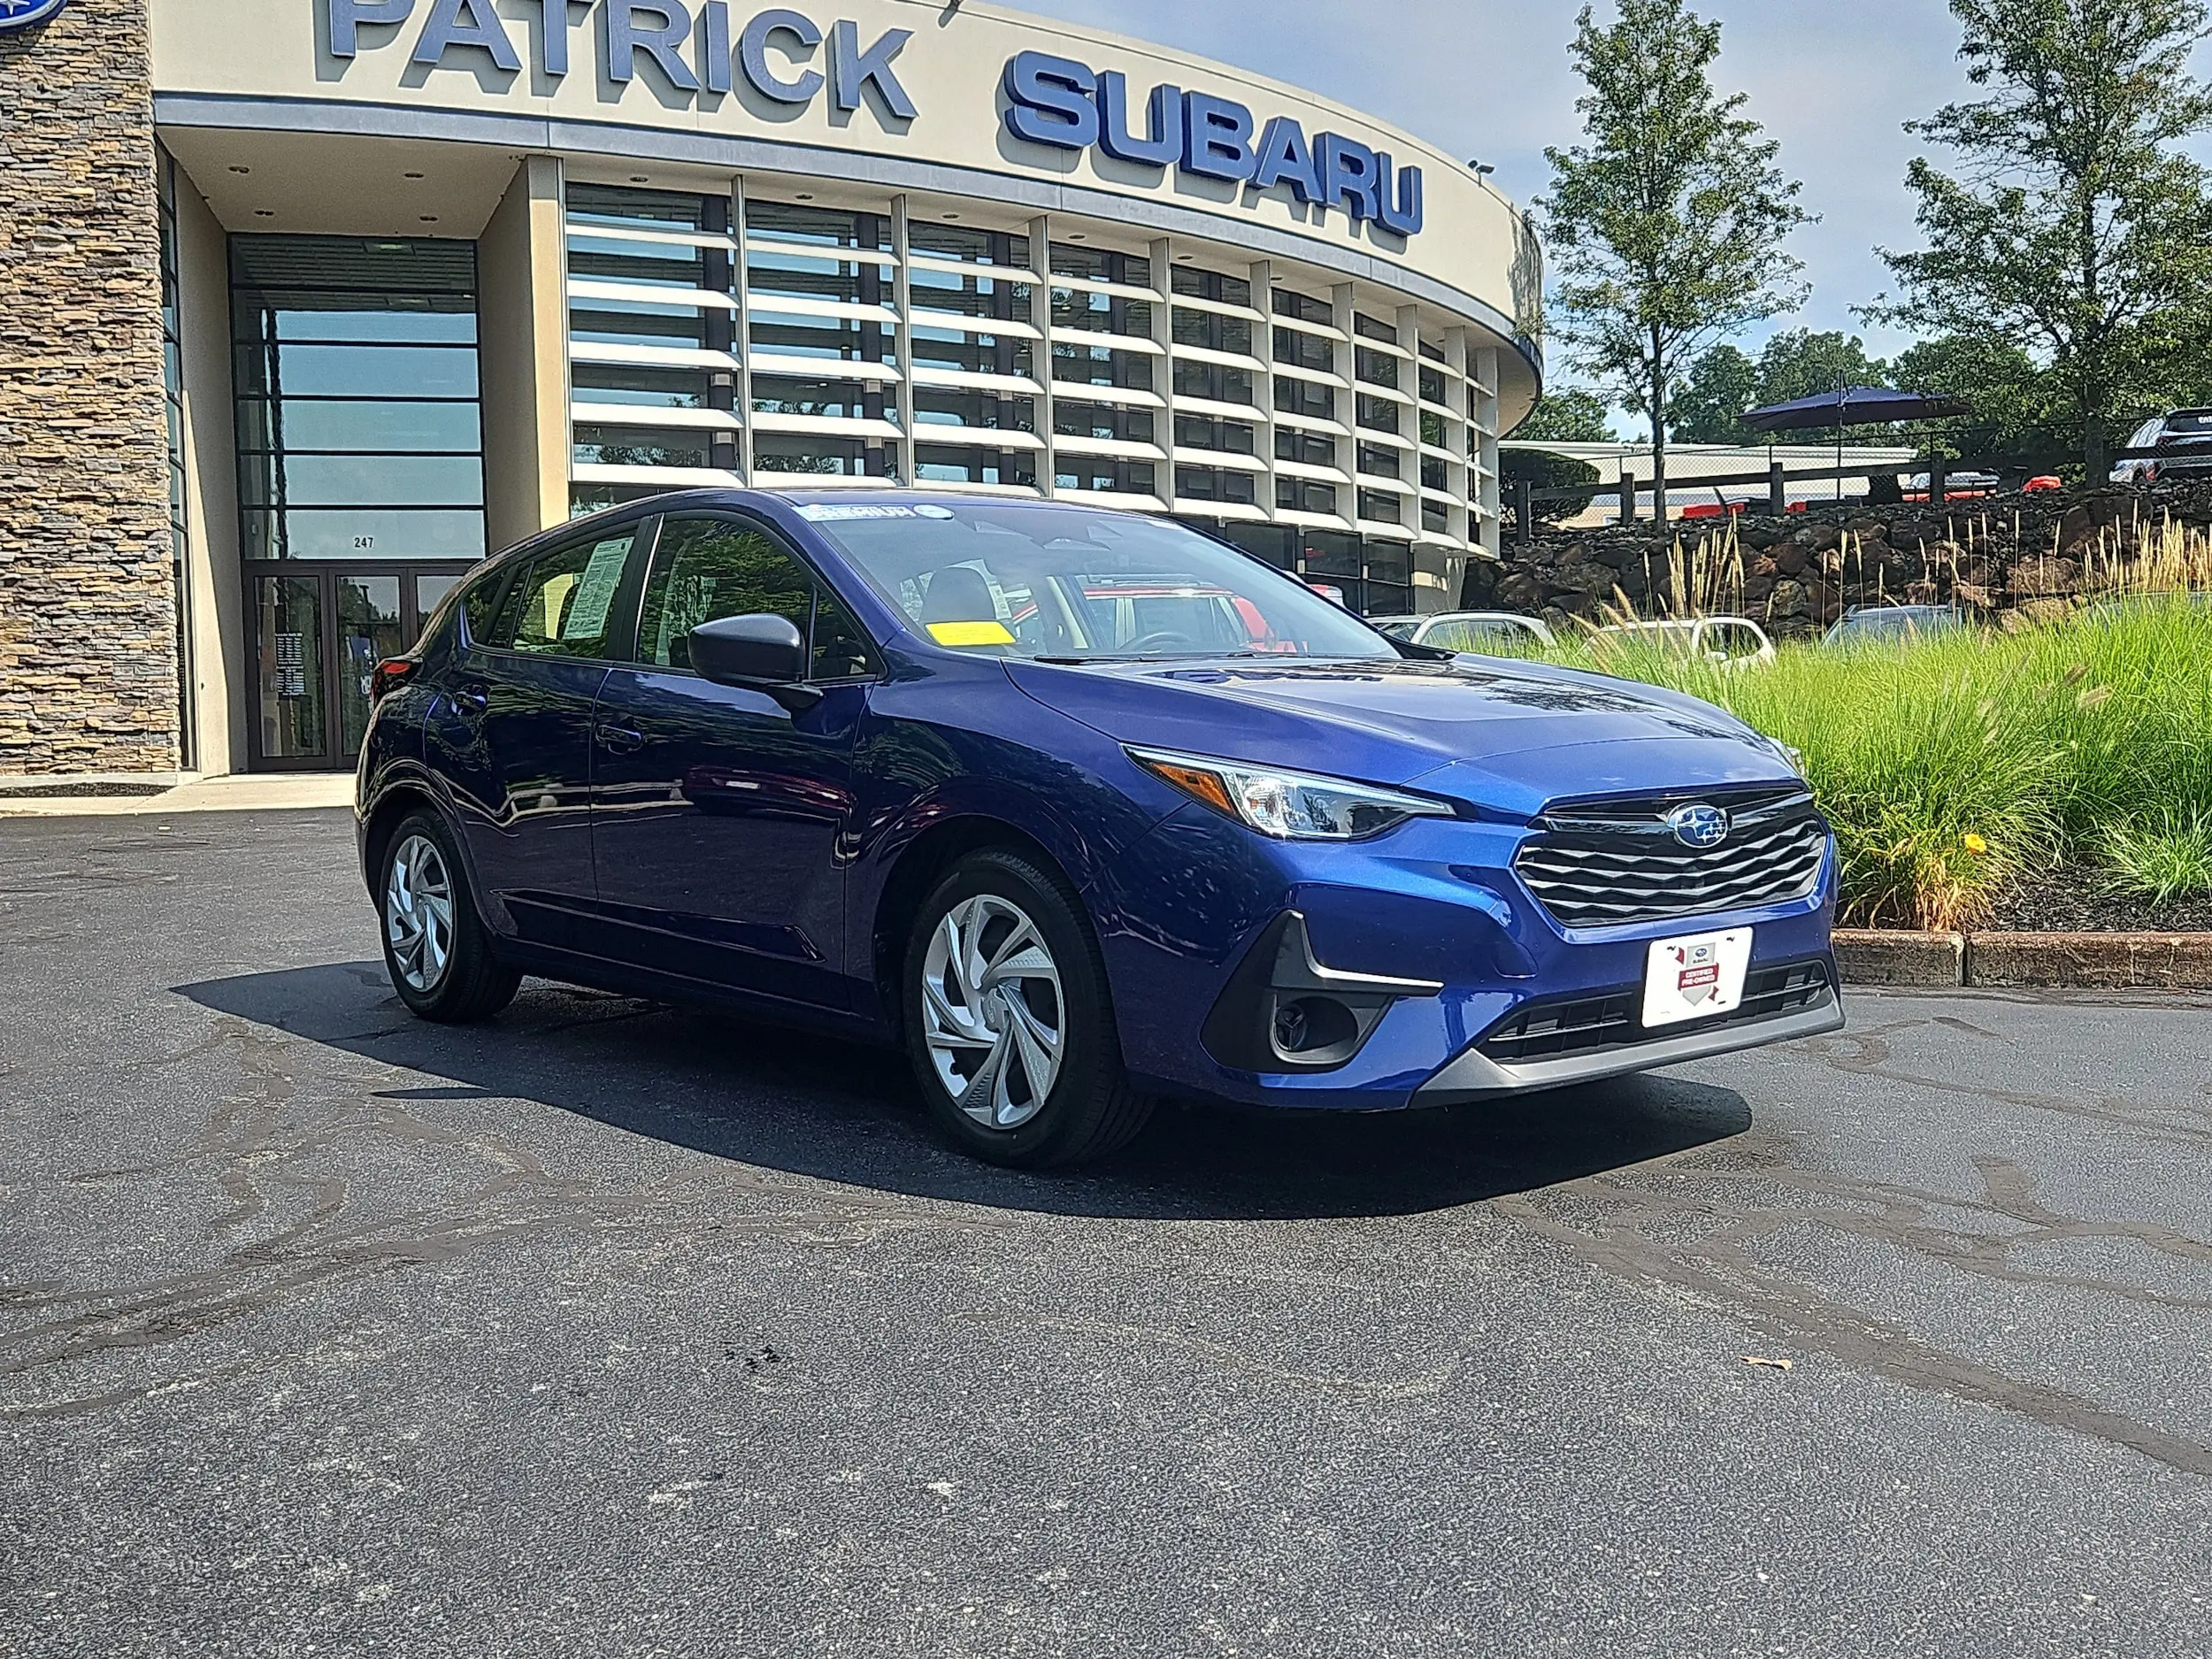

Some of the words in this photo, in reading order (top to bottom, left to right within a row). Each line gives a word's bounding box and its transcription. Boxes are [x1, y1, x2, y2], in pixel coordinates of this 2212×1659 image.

[330, 0, 920, 119] PATRICK
[1003, 50, 1422, 236] SUBARU
[354, 537, 374, 549] 247
[1686, 968, 1714, 979] CERTIFIED
[1681, 974, 1716, 987] PRE-OWNED
